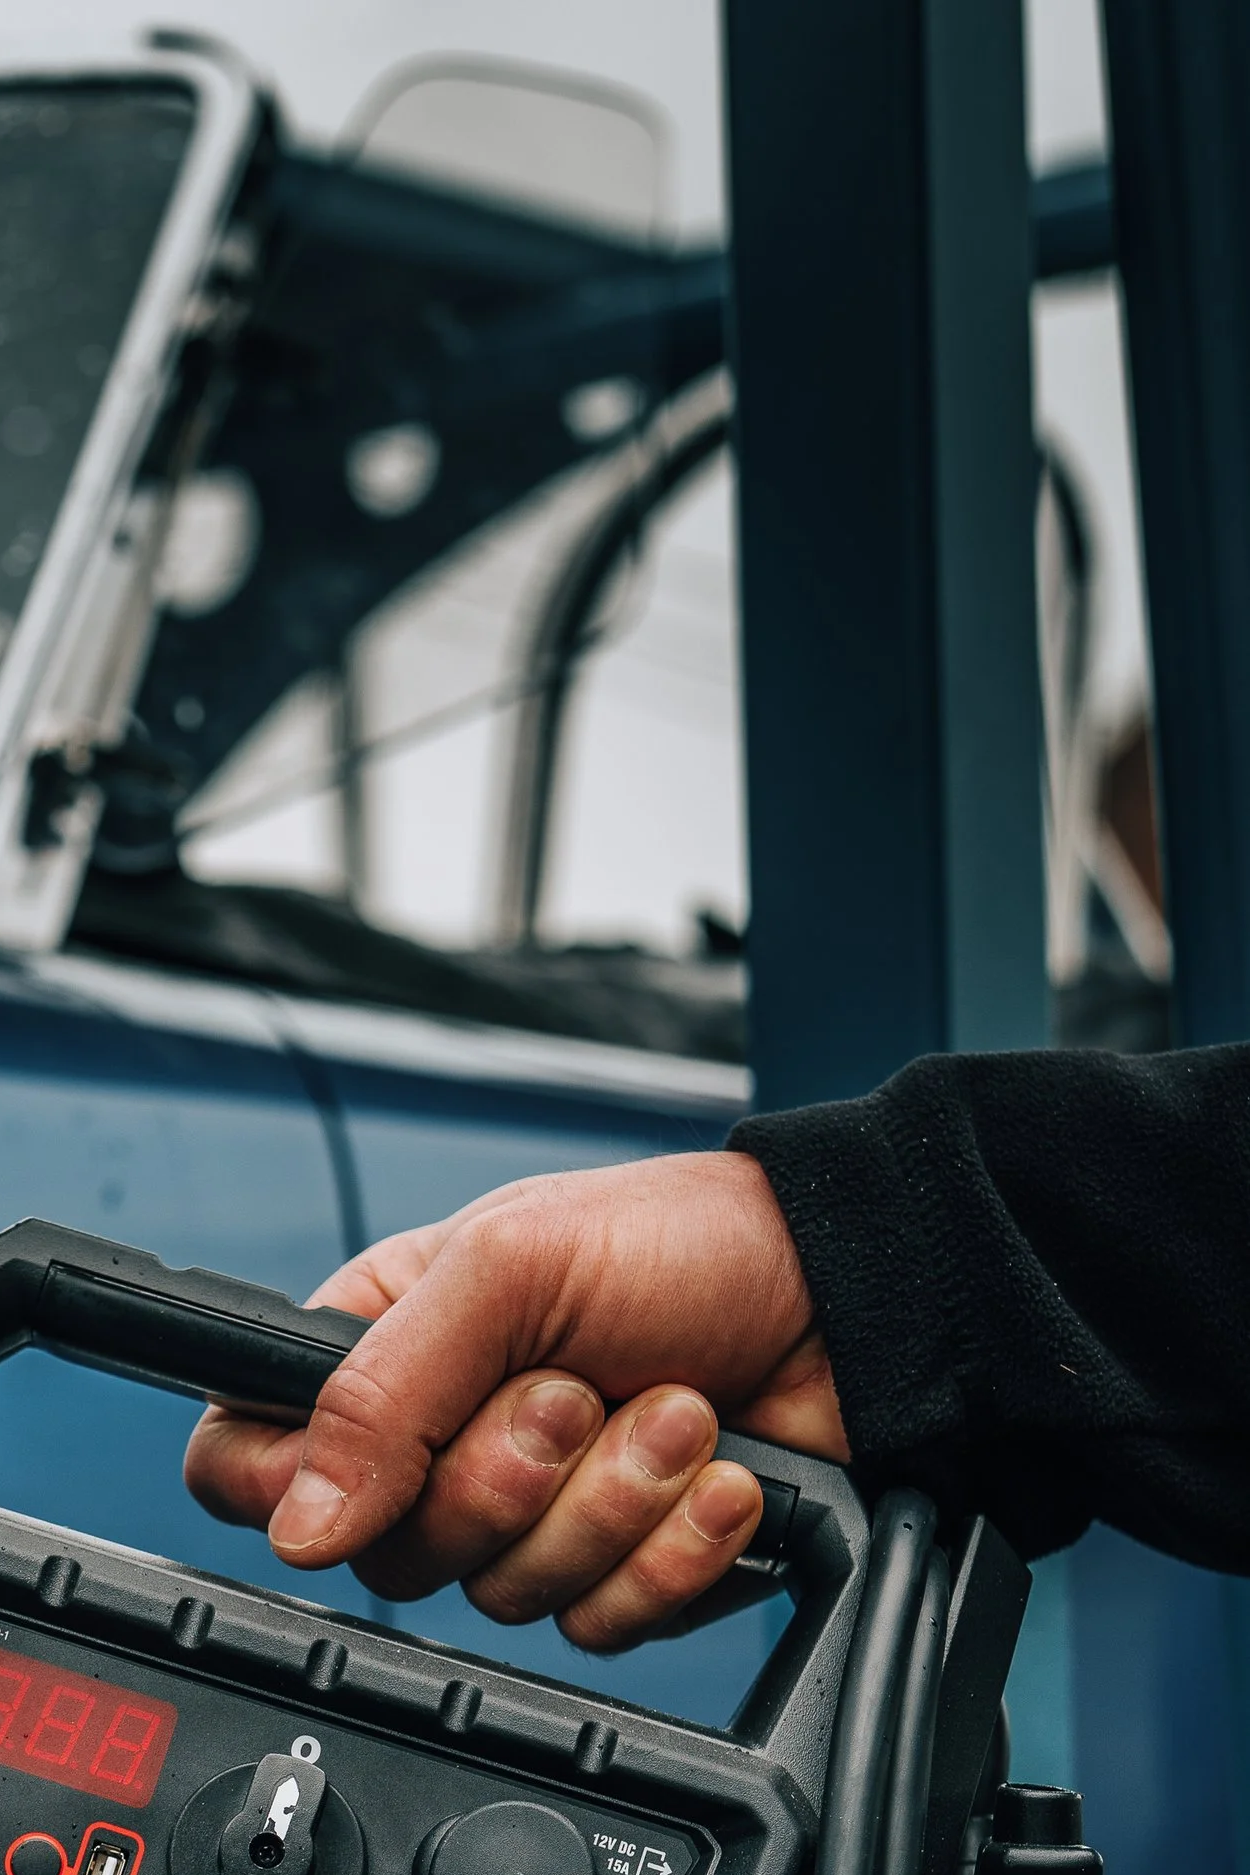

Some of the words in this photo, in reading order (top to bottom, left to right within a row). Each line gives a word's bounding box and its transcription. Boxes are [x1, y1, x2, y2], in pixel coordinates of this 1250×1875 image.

[593, 1833, 617, 1851] 12V
[617, 1842, 637, 1858] DC
[607, 1857, 630, 1875] 15A
